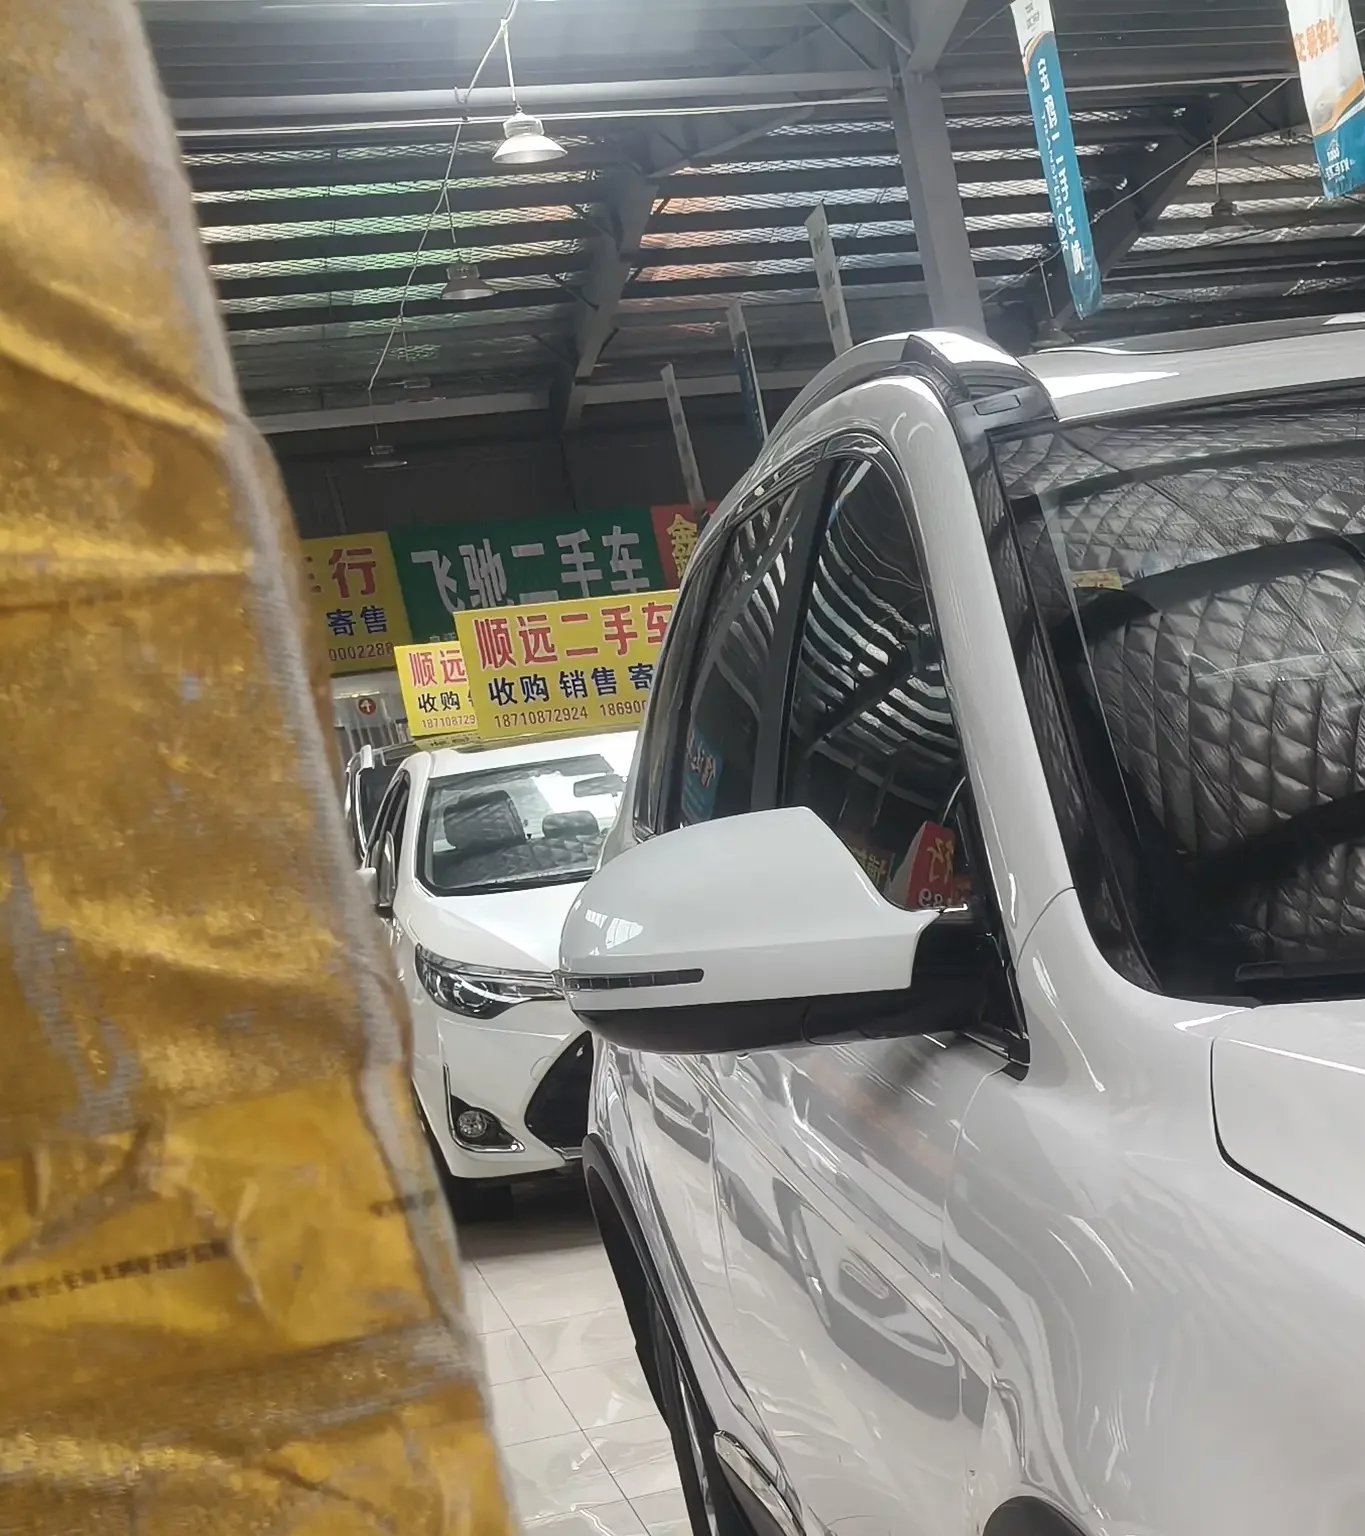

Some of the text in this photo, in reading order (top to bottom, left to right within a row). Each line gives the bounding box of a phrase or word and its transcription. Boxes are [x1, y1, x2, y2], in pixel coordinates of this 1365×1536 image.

[411, 525, 650, 613] 飞驰二手车
[326, 605, 388, 636] 寄售
[472, 602, 674, 670] 顺远二手车
[409, 649, 468, 687] 顺远
[488, 673, 550, 706] 收购
[559, 667, 617, 698] 销售
[418, 691, 460, 713] 收购
[494, 706, 588, 729] 18710872924
